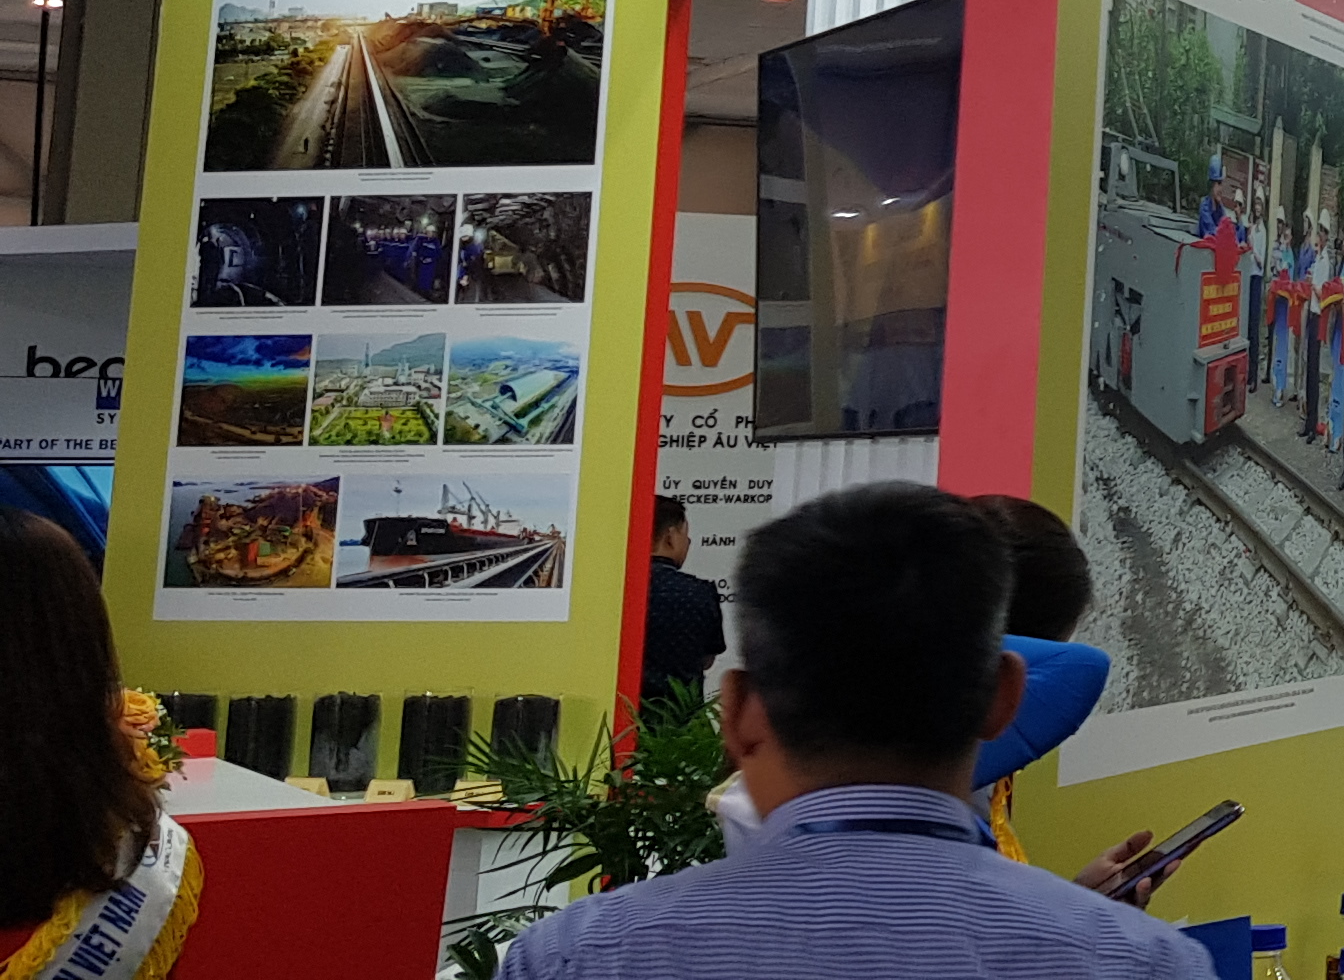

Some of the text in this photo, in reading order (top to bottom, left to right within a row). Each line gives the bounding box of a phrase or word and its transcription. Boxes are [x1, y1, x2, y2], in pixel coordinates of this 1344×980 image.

[692, 408, 718, 428] CỔ
[0, 439, 33, 450] ART
[39, 439, 59, 450] OF
[64, 439, 93, 450] THE
[748, 480, 773, 489] DUY
[68, 883, 148, 977] VIỆT NAM
